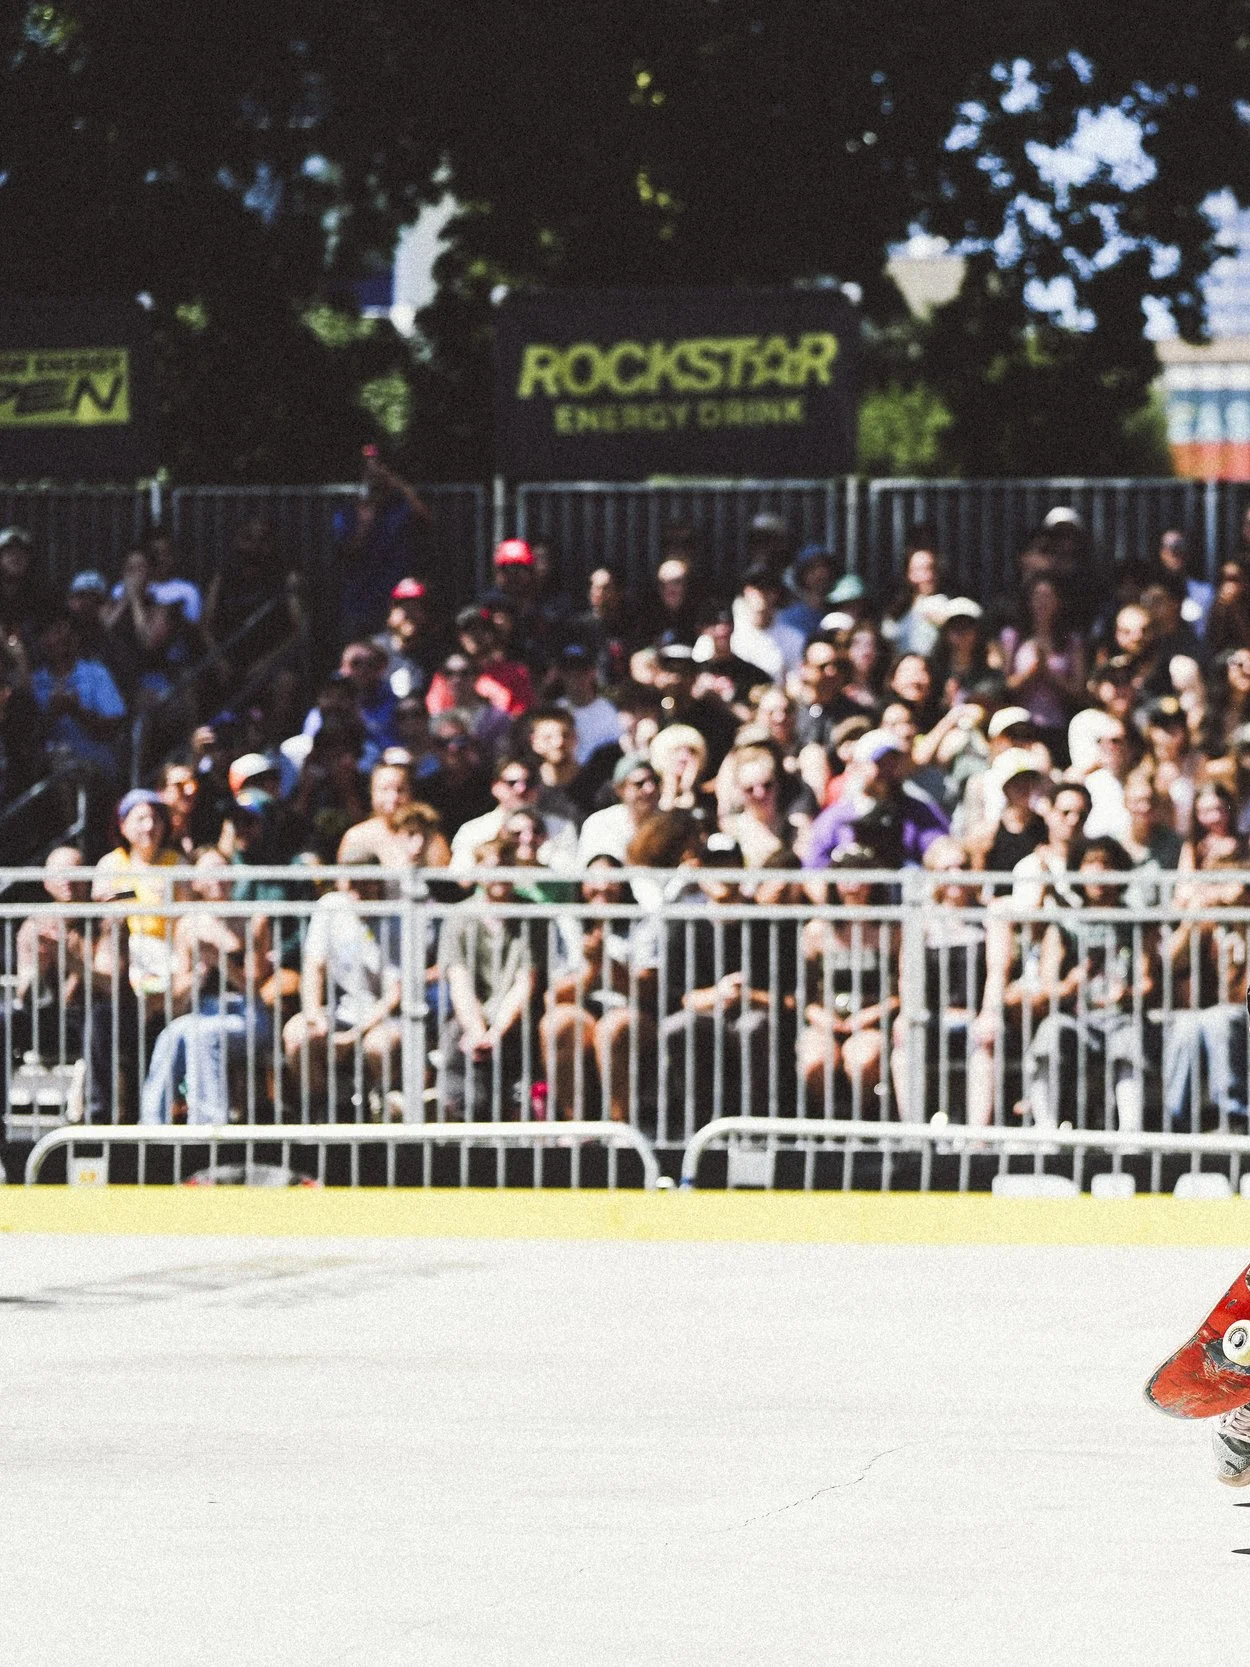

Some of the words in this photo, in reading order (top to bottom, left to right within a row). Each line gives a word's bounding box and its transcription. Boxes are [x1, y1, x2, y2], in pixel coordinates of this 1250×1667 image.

[518, 331, 837, 397] ROCKSTAR
[555, 403, 689, 434] ENERGY
[697, 398, 802, 428] DRINK
